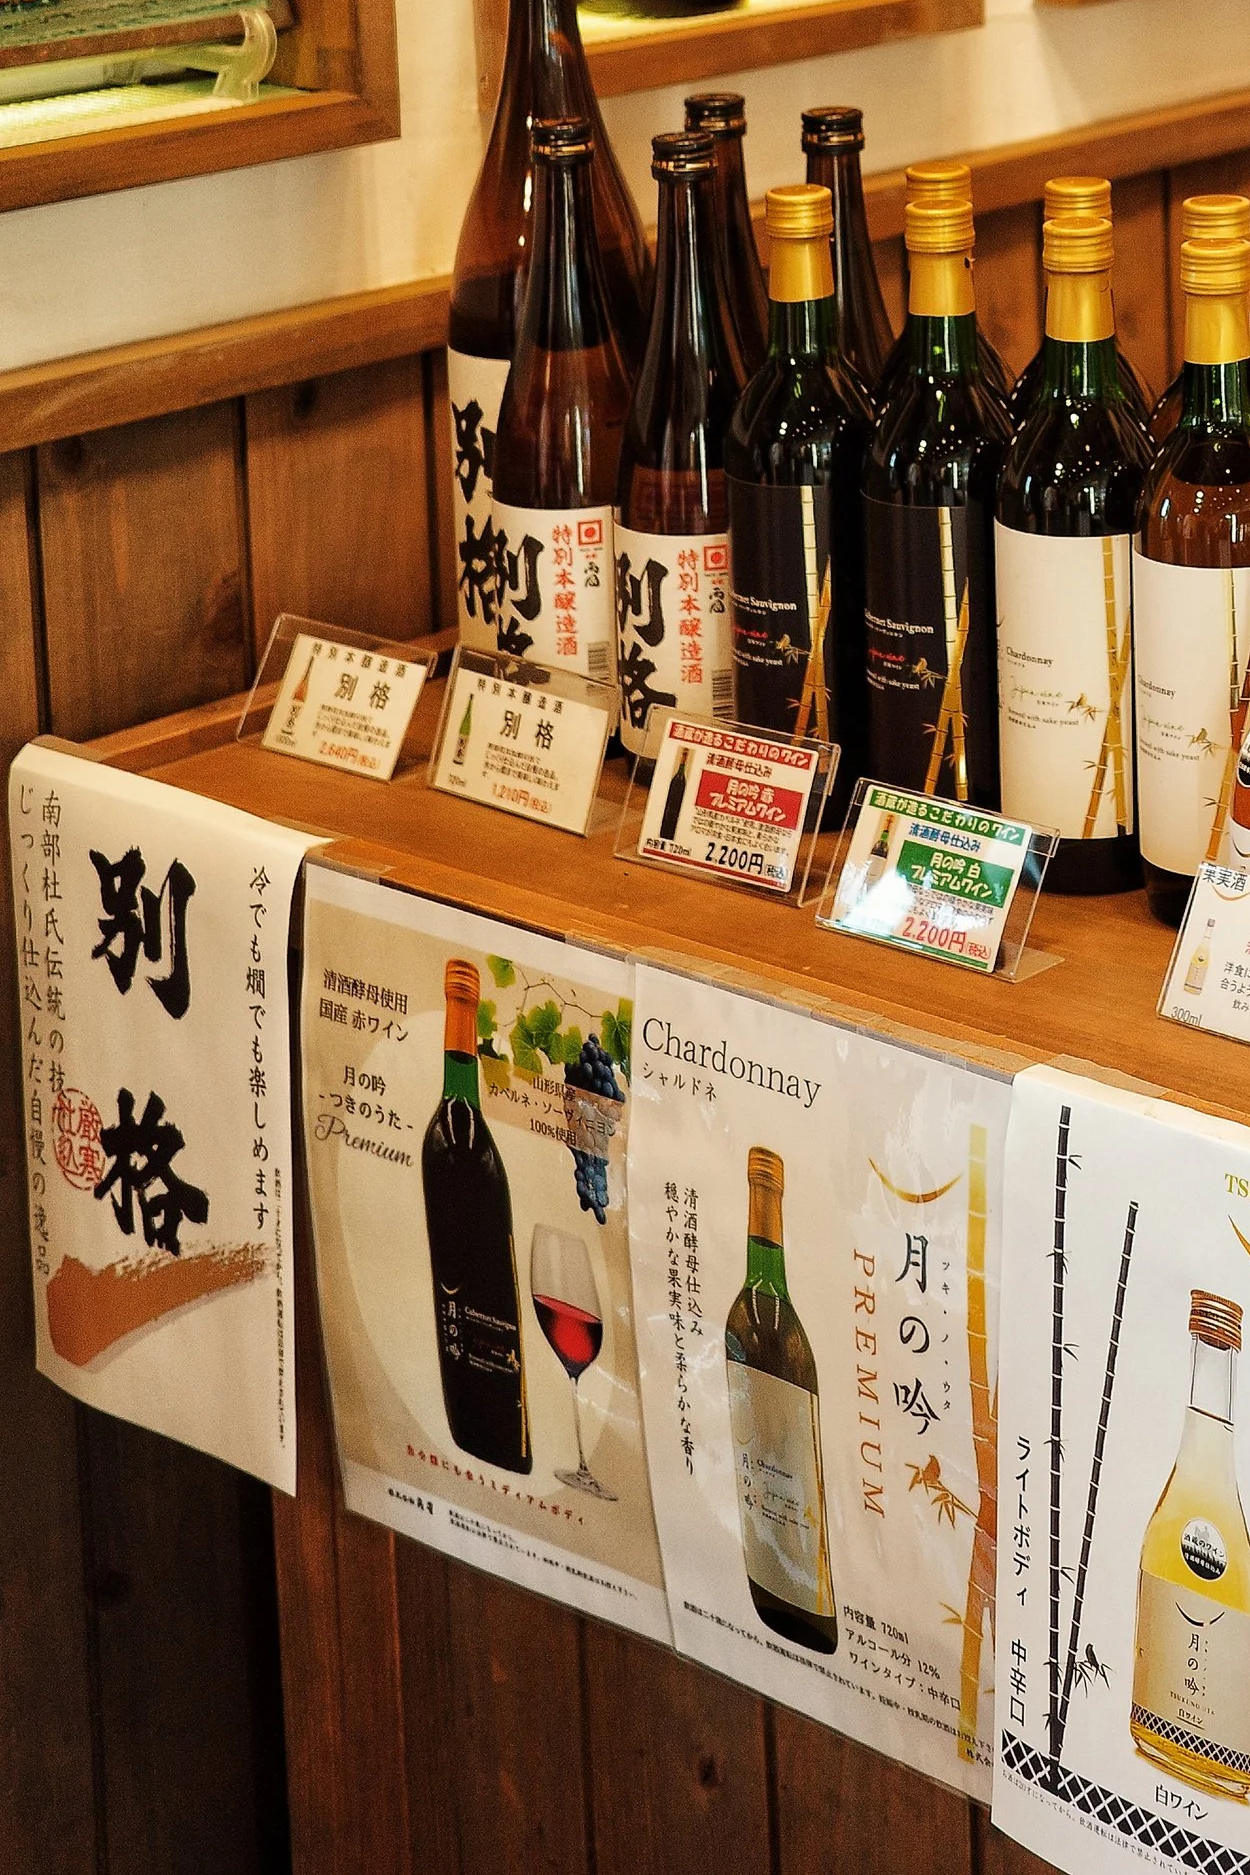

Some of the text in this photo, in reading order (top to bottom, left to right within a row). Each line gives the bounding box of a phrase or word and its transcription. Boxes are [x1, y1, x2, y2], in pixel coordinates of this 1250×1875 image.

[553, 525, 579, 656] 特別本醸造酒
[750, 597, 797, 612] Sauvignon
[678, 549, 704, 684] 特別本醸造酒
[887, 620, 934, 635] Sauvignon
[1006, 646, 1055, 668] Chardonnay
[334, 673, 392, 711] 別格
[477, 678, 564, 713] 特別本醸造酒
[500, 709, 555, 750] 別格
[709, 791, 787, 823] プレミアムワイン
[1202, 862, 1248, 892] 果実酒
[323, 967, 409, 1015] 清酒酵母使用
[319, 998, 409, 1043] 国産 赤ワイン
[1171, 1005, 1202, 1026] 300ml
[88, 845, 210, 1257] 別格
[246, 865, 271, 1231] 冷でも燗でも楽しめます
[642, 1017, 822, 1109] Chardonnay
[343, 1065, 387, 1097] 月の吟
[532, 1076, 577, 1103] 山形県産
[641, 1061, 718, 1102] シャルドネ
[314, 1113, 414, 1168] Premium
[530, 1117, 579, 1147] 100%使用
[682, 1186, 705, 1337] 清酒酵母仕込み
[663, 1181, 696, 1477] 穏やかな果実味と柔らかな香り
[892, 1231, 942, 1437] 月の吟
[853, 1248, 886, 1520] PREMIUM
[1010, 1436, 1031, 1727] ライトボディ 中辛口
[843, 1604, 910, 1645] 内容量 720ml
[845, 1627, 942, 1681] アルコール分 12%
[1183, 1633, 1201, 1696] 月の吟
[1177, 1708, 1203, 1726] 白ワイン
[1155, 1783, 1209, 1822] 白ワイン
